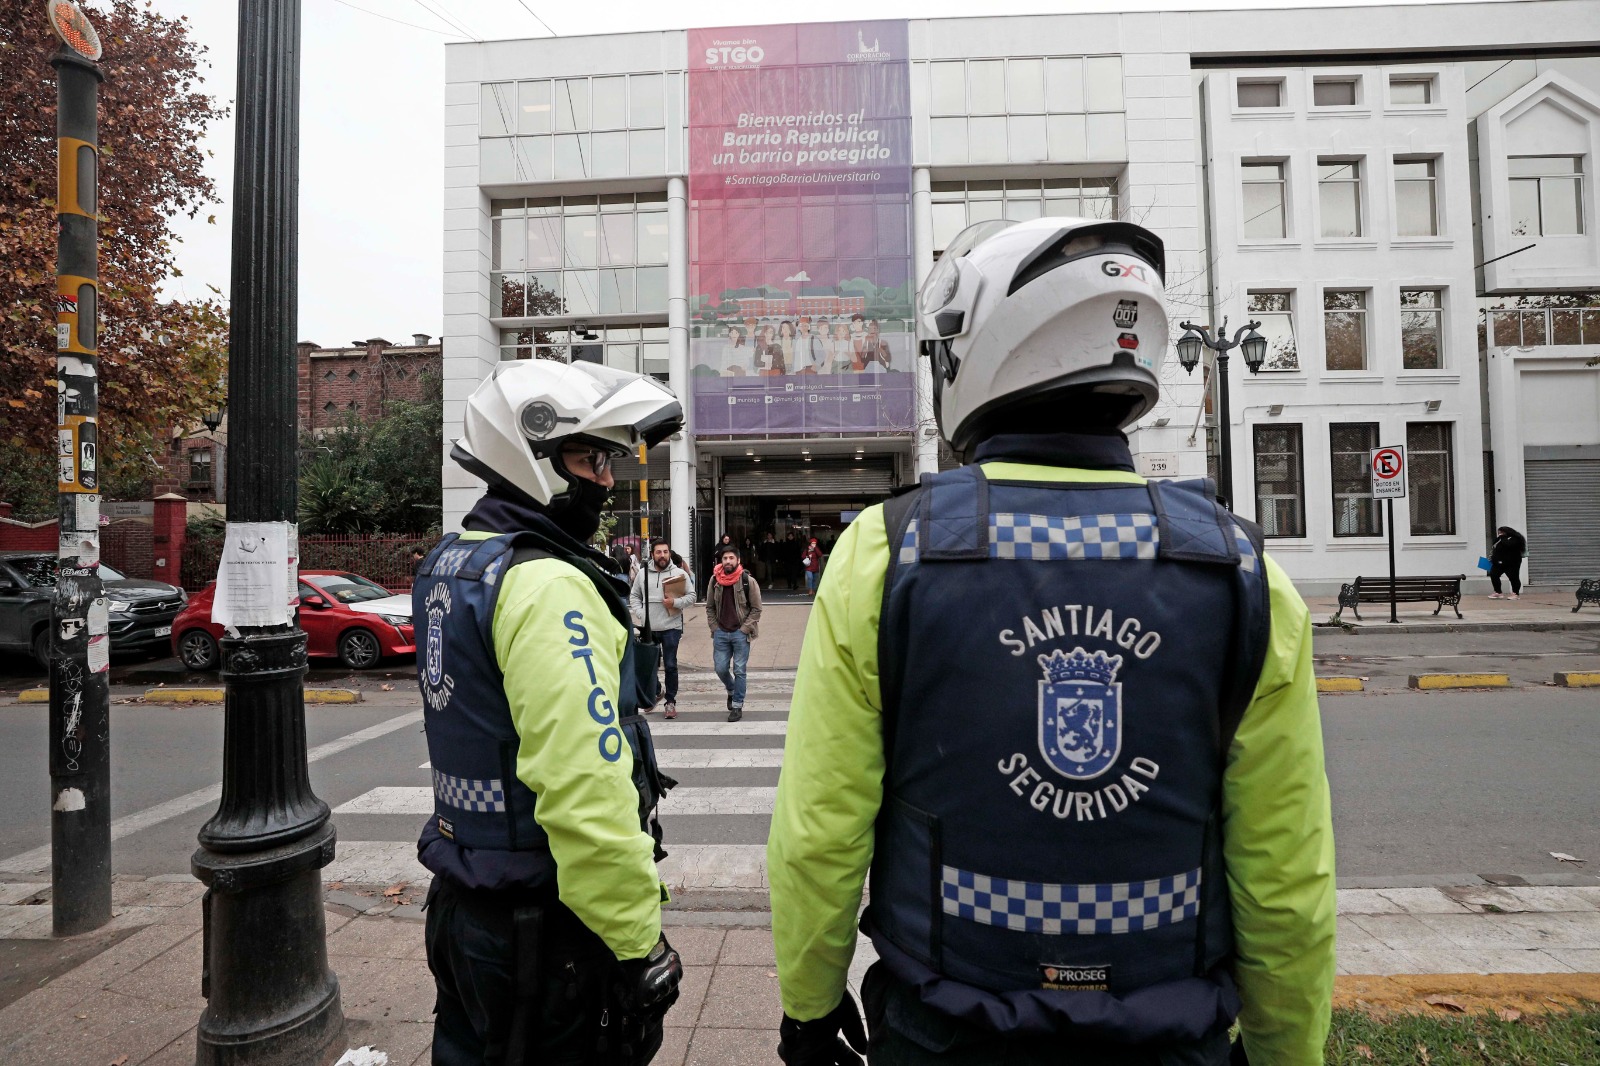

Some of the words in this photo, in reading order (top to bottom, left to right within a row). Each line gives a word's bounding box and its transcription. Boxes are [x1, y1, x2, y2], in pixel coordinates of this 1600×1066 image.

[705, 46, 764, 64] STGO
[737, 110, 843, 128] Bienvenidos
[847, 108, 865, 125] al
[723, 130, 782, 147] Barrio
[786, 127, 879, 147] República
[712, 153, 735, 165] un
[739, 148, 793, 165] barrio
[796, 144, 891, 166] protegido
[724, 171, 881, 187] #SantiagoBarrioUniversitario
[1101, 260, 1148, 284] GXT
[1151, 463, 1167, 471] 239
[425, 582, 451, 614] SANTIAGO
[999, 604, 1161, 659] SANTIAGO
[420, 668, 455, 712] SEGURIDAD
[563, 610, 622, 762] STGO
[998, 752, 1160, 821] SEGURIDAD
[1060, 970, 1106, 981] PROSEG
